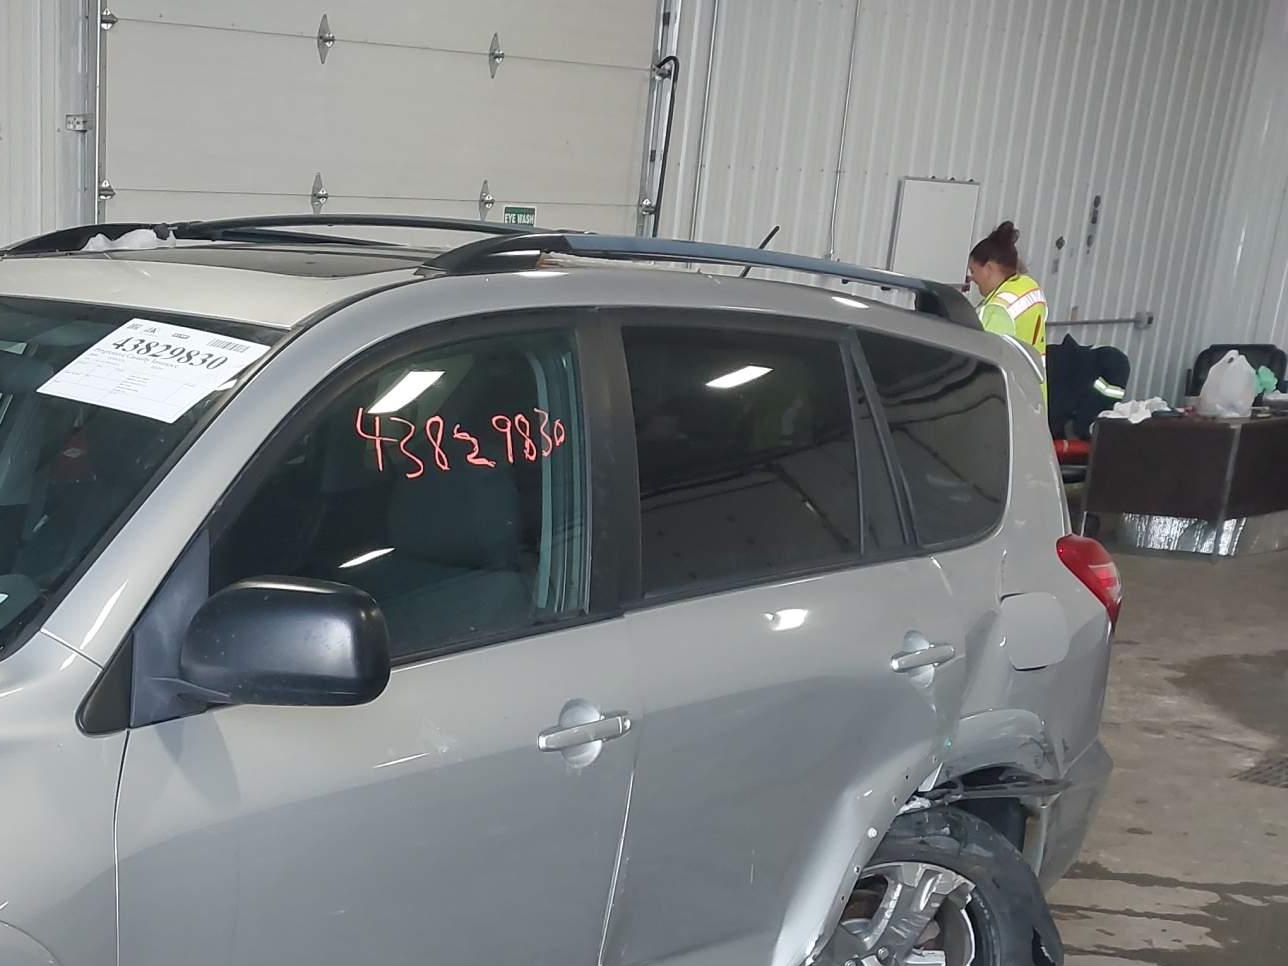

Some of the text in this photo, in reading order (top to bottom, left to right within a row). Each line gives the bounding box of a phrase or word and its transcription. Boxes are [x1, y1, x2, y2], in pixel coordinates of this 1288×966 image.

[505, 213, 534, 224] EYE WASH
[112, 336, 229, 370] 43829830
[356, 406, 565, 478] 43829830
